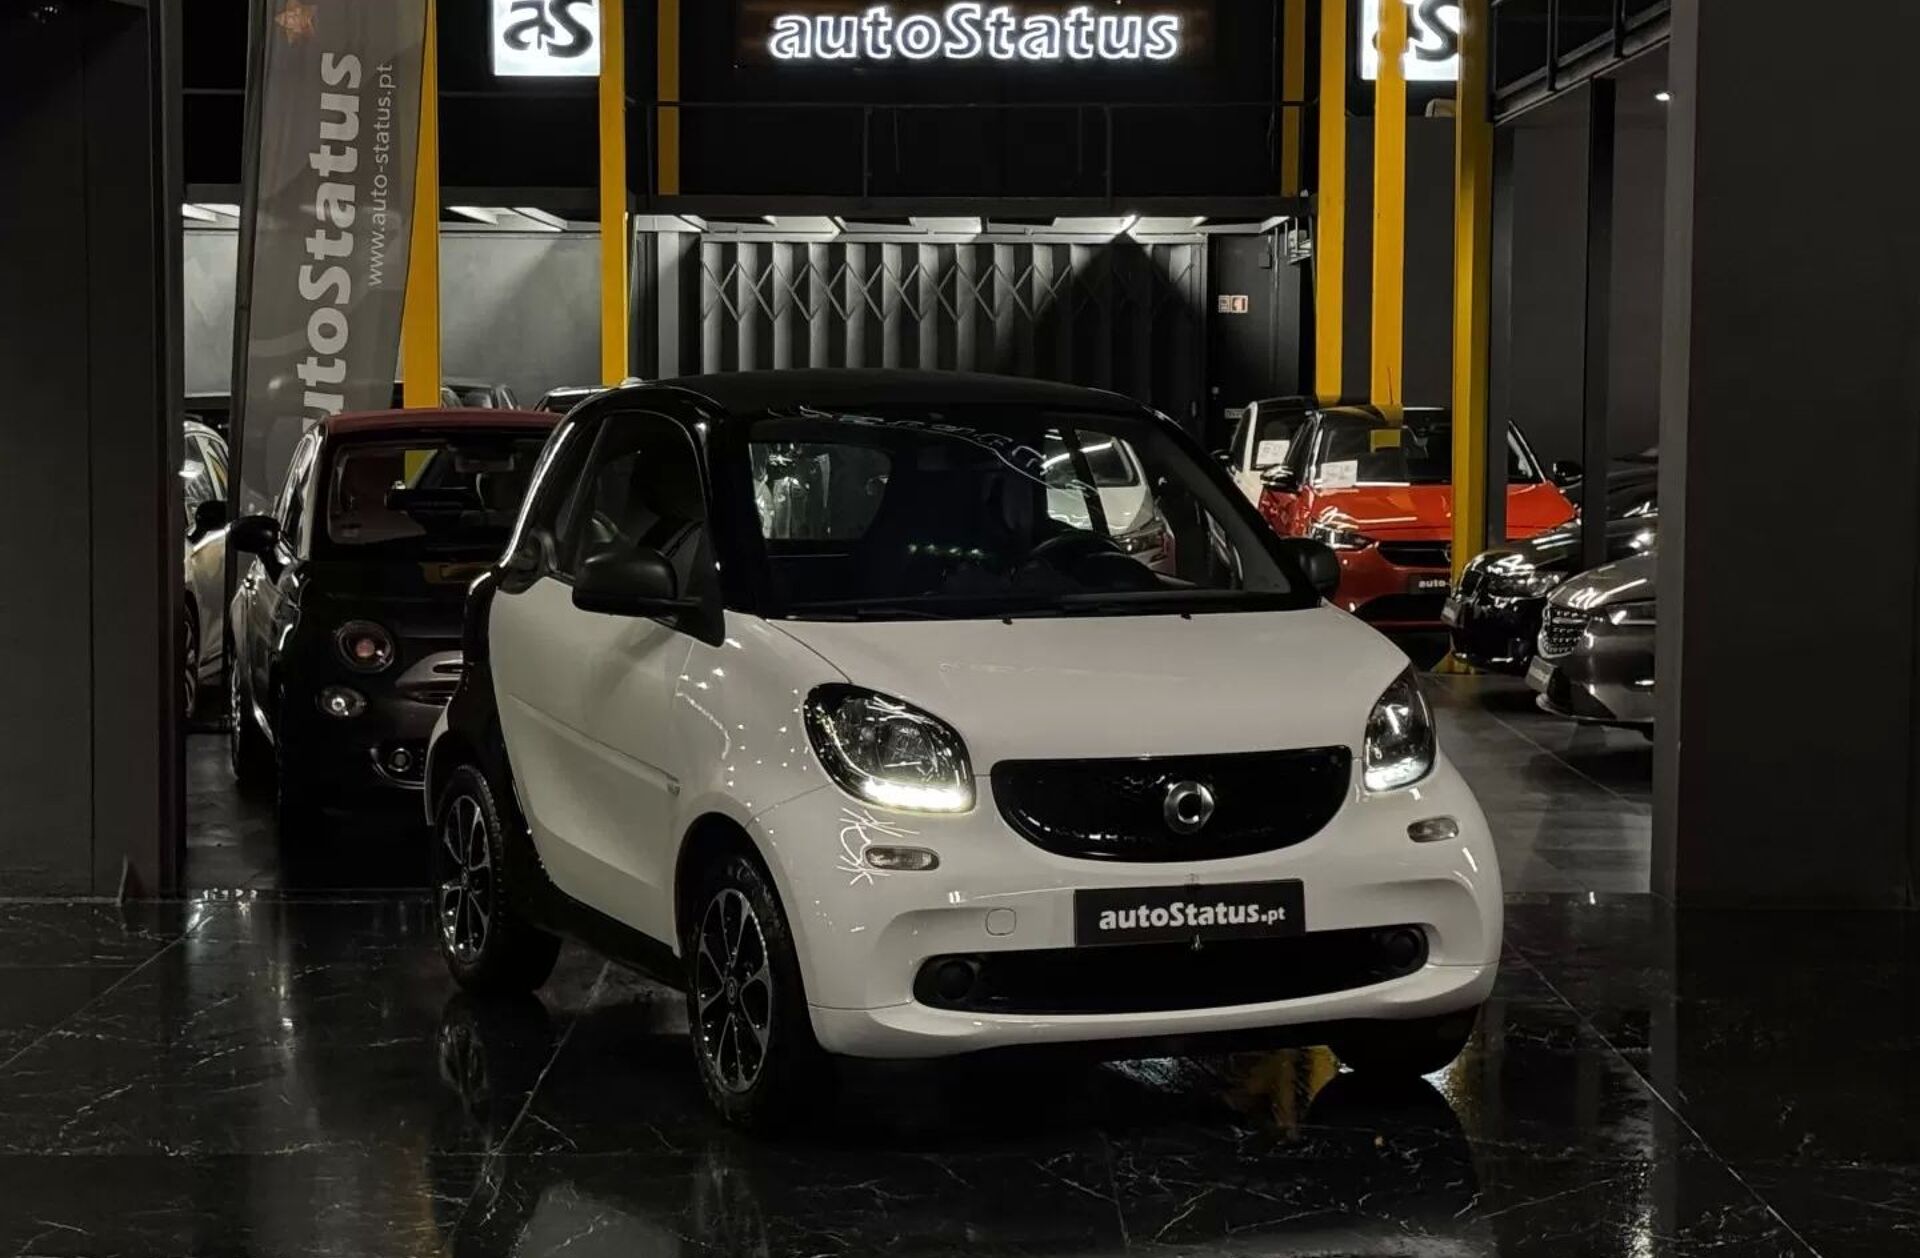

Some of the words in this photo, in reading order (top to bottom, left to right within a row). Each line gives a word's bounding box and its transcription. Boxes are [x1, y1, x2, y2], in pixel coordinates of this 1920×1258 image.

[769, 3, 1180, 60] autoStatus
[297, 52, 362, 433] utoStatus
[368, 64, 397, 287] www.auto-status.pt
[1099, 902, 1286, 930] autoStatus.pt
